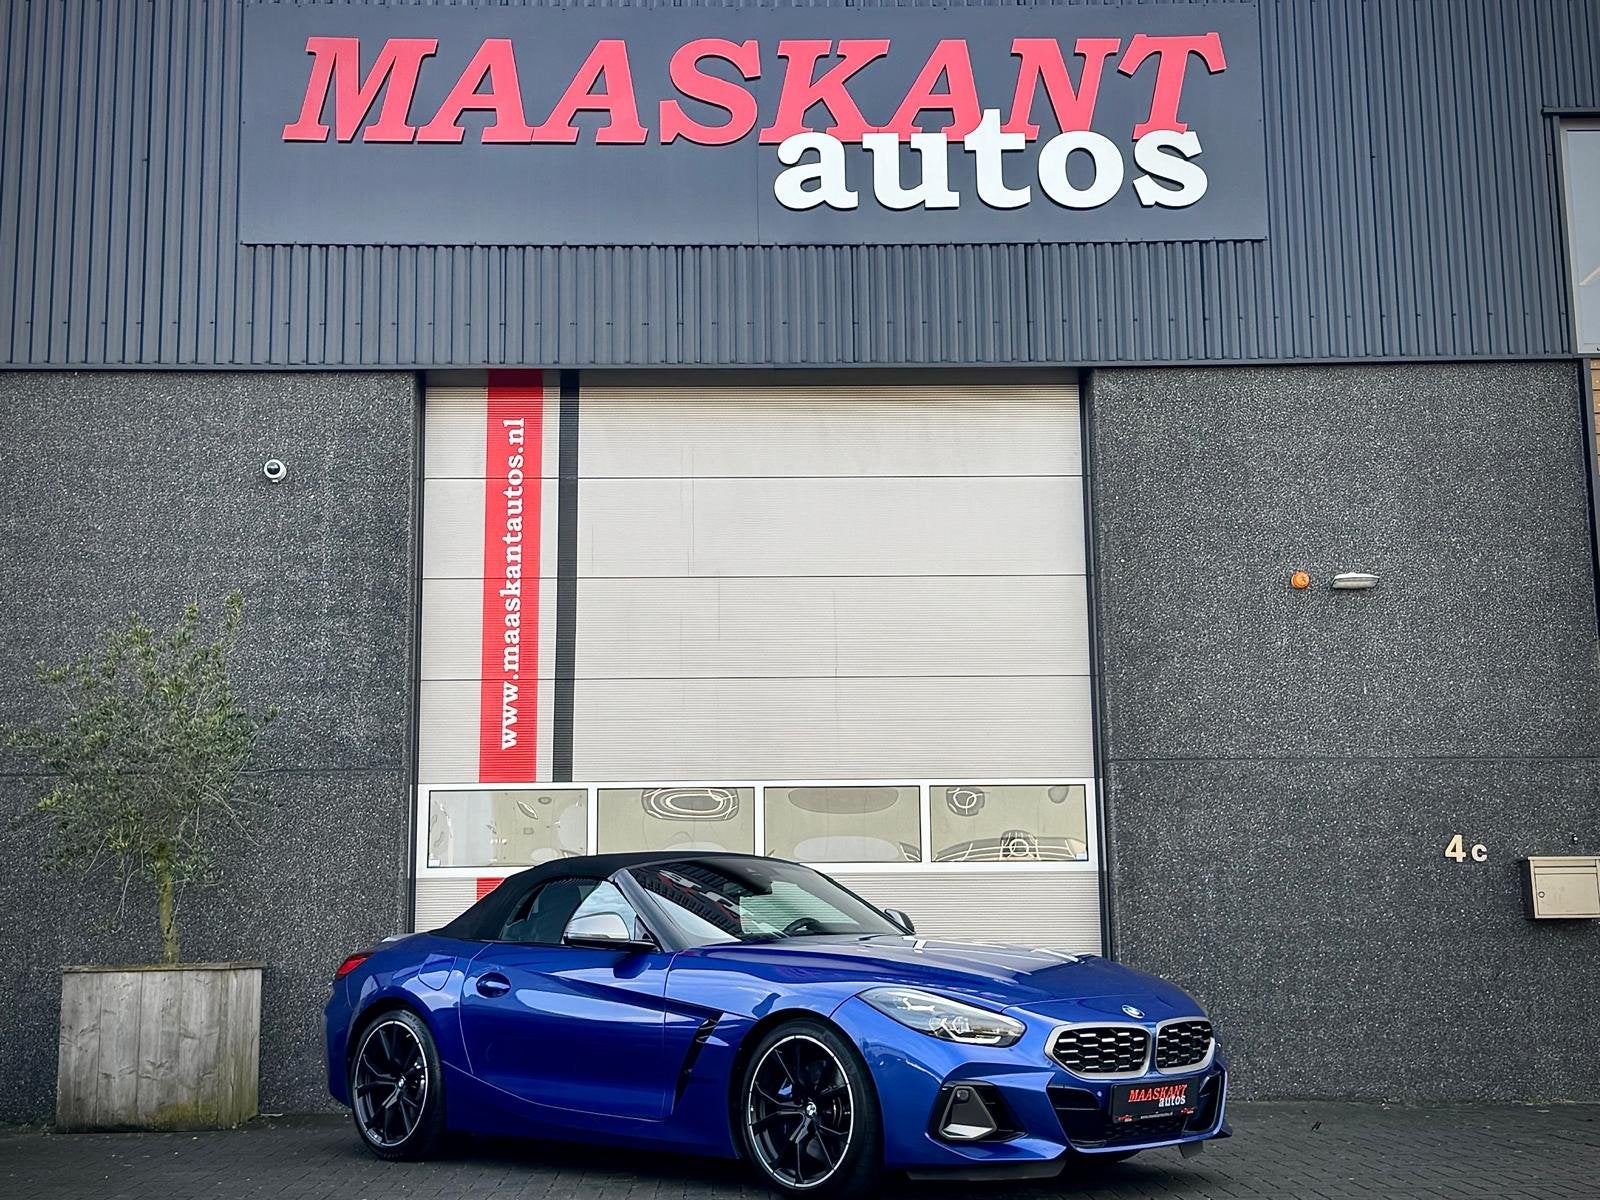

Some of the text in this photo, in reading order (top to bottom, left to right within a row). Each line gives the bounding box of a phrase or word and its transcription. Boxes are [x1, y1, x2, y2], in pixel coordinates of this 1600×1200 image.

[282, 32, 1226, 145] MAASKANT
[774, 108, 1208, 210] autos
[499, 417, 526, 750] www.maaskantautos.nl
[1128, 1084, 1188, 1103] MAASKANT
[1158, 1095, 1186, 1108] autos
